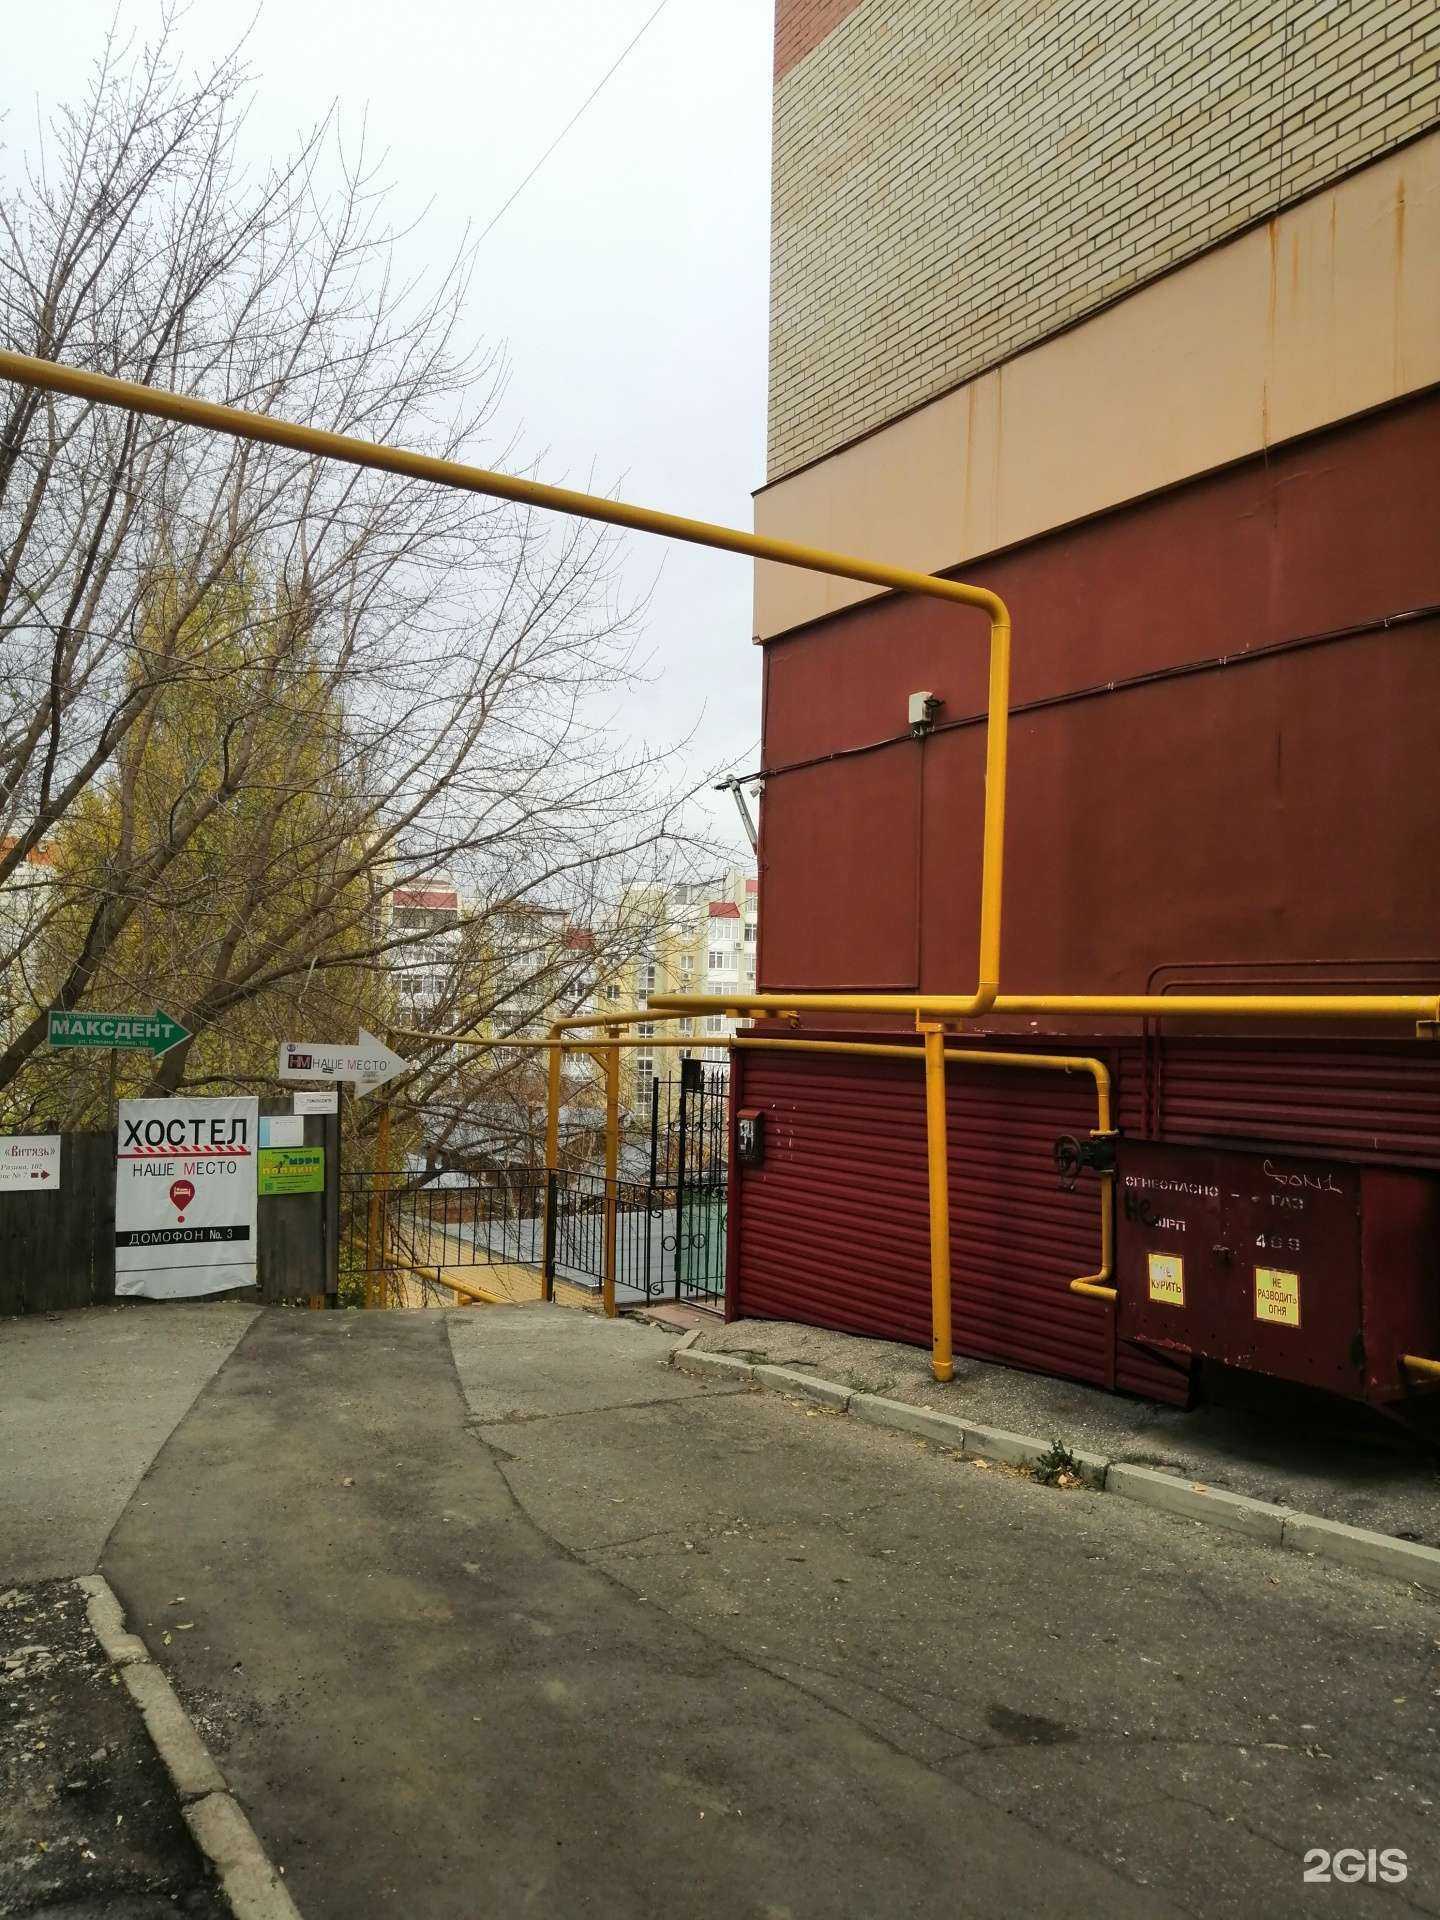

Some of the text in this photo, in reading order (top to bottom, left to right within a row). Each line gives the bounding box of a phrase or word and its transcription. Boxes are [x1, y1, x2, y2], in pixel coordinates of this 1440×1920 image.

[52, 1019, 174, 1040] МАКСДЕНТ
[312, 1058, 343, 1070] НАШЕ
[124, 1118, 247, 1147] ХОСТЕЛ
[133, 1160, 237, 1177] НАШЕ МЕСТО
[129, 1230, 204, 1246] ДОМОФОН
[226, 1228, 233, 1239] 3
[1152, 1279, 1182, 1293] КУРИТЬ
[1272, 1277, 1282, 1289] НЕ
[1257, 1288, 1297, 1305] РАЗВОДИТЬ
[1268, 1304, 1287, 1316] ОГНЯ
